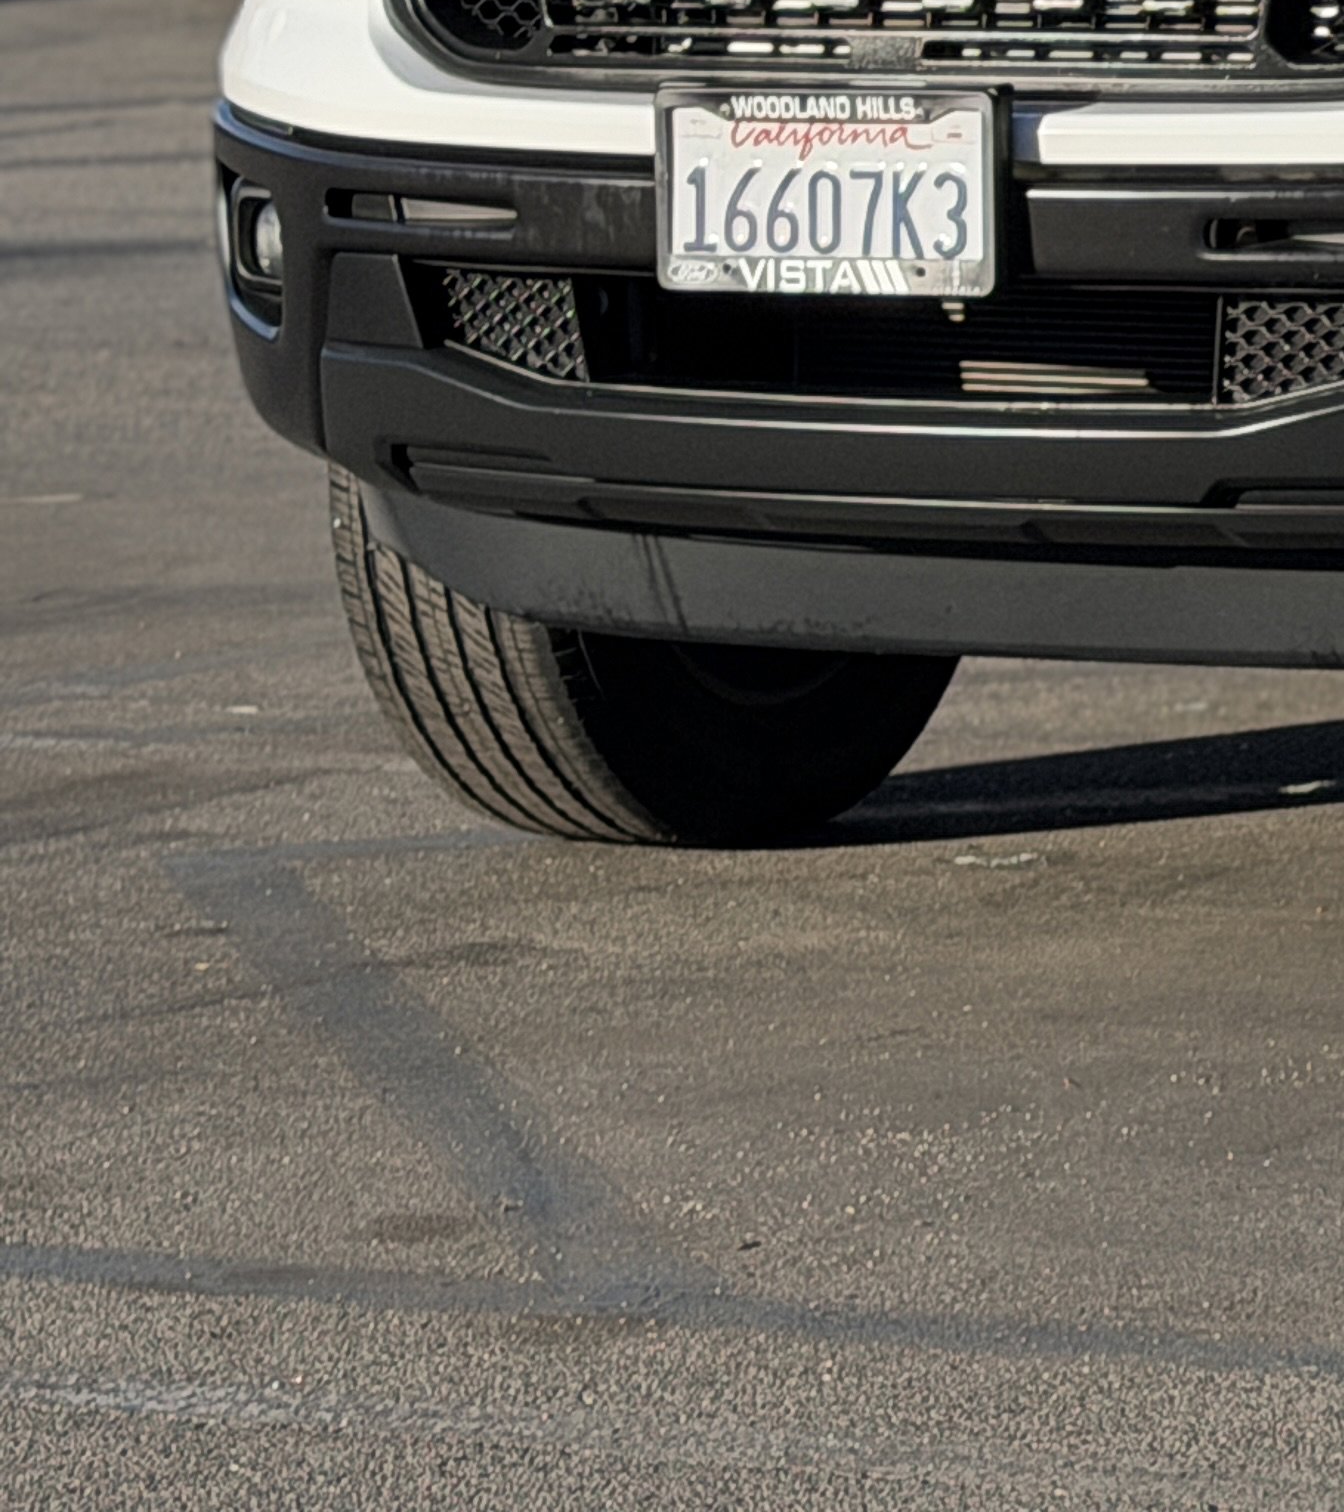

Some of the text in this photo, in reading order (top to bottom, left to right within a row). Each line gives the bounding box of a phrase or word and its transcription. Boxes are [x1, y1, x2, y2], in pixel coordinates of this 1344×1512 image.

[730, 95, 916, 120] WOODLAND HILLS
[730, 120, 933, 161] California
[683, 162, 968, 260] 16607K3
[738, 259, 862, 292] VISTA
